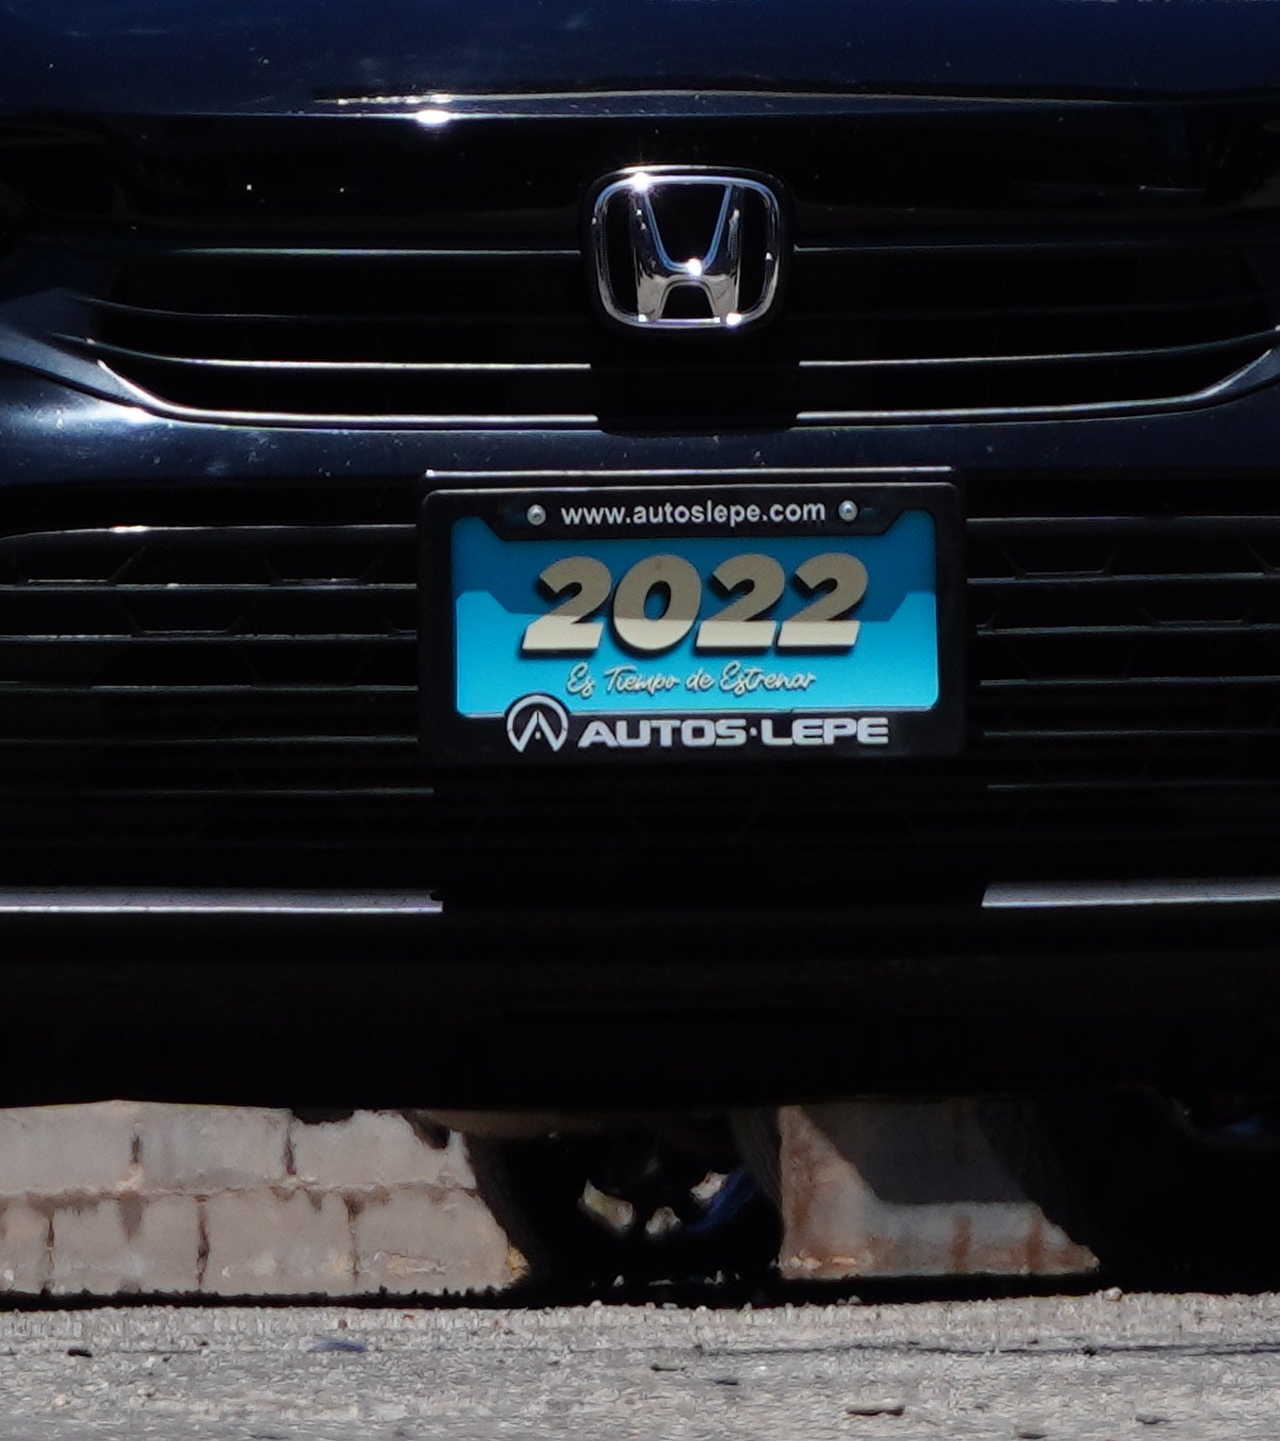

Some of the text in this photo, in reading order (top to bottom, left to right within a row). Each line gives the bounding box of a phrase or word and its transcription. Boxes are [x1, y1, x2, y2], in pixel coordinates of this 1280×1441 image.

[560, 499, 826, 528] www.autoslepe.com
[521, 552, 869, 652] 2022
[566, 660, 818, 698] Es Tiempo de Estrenar
